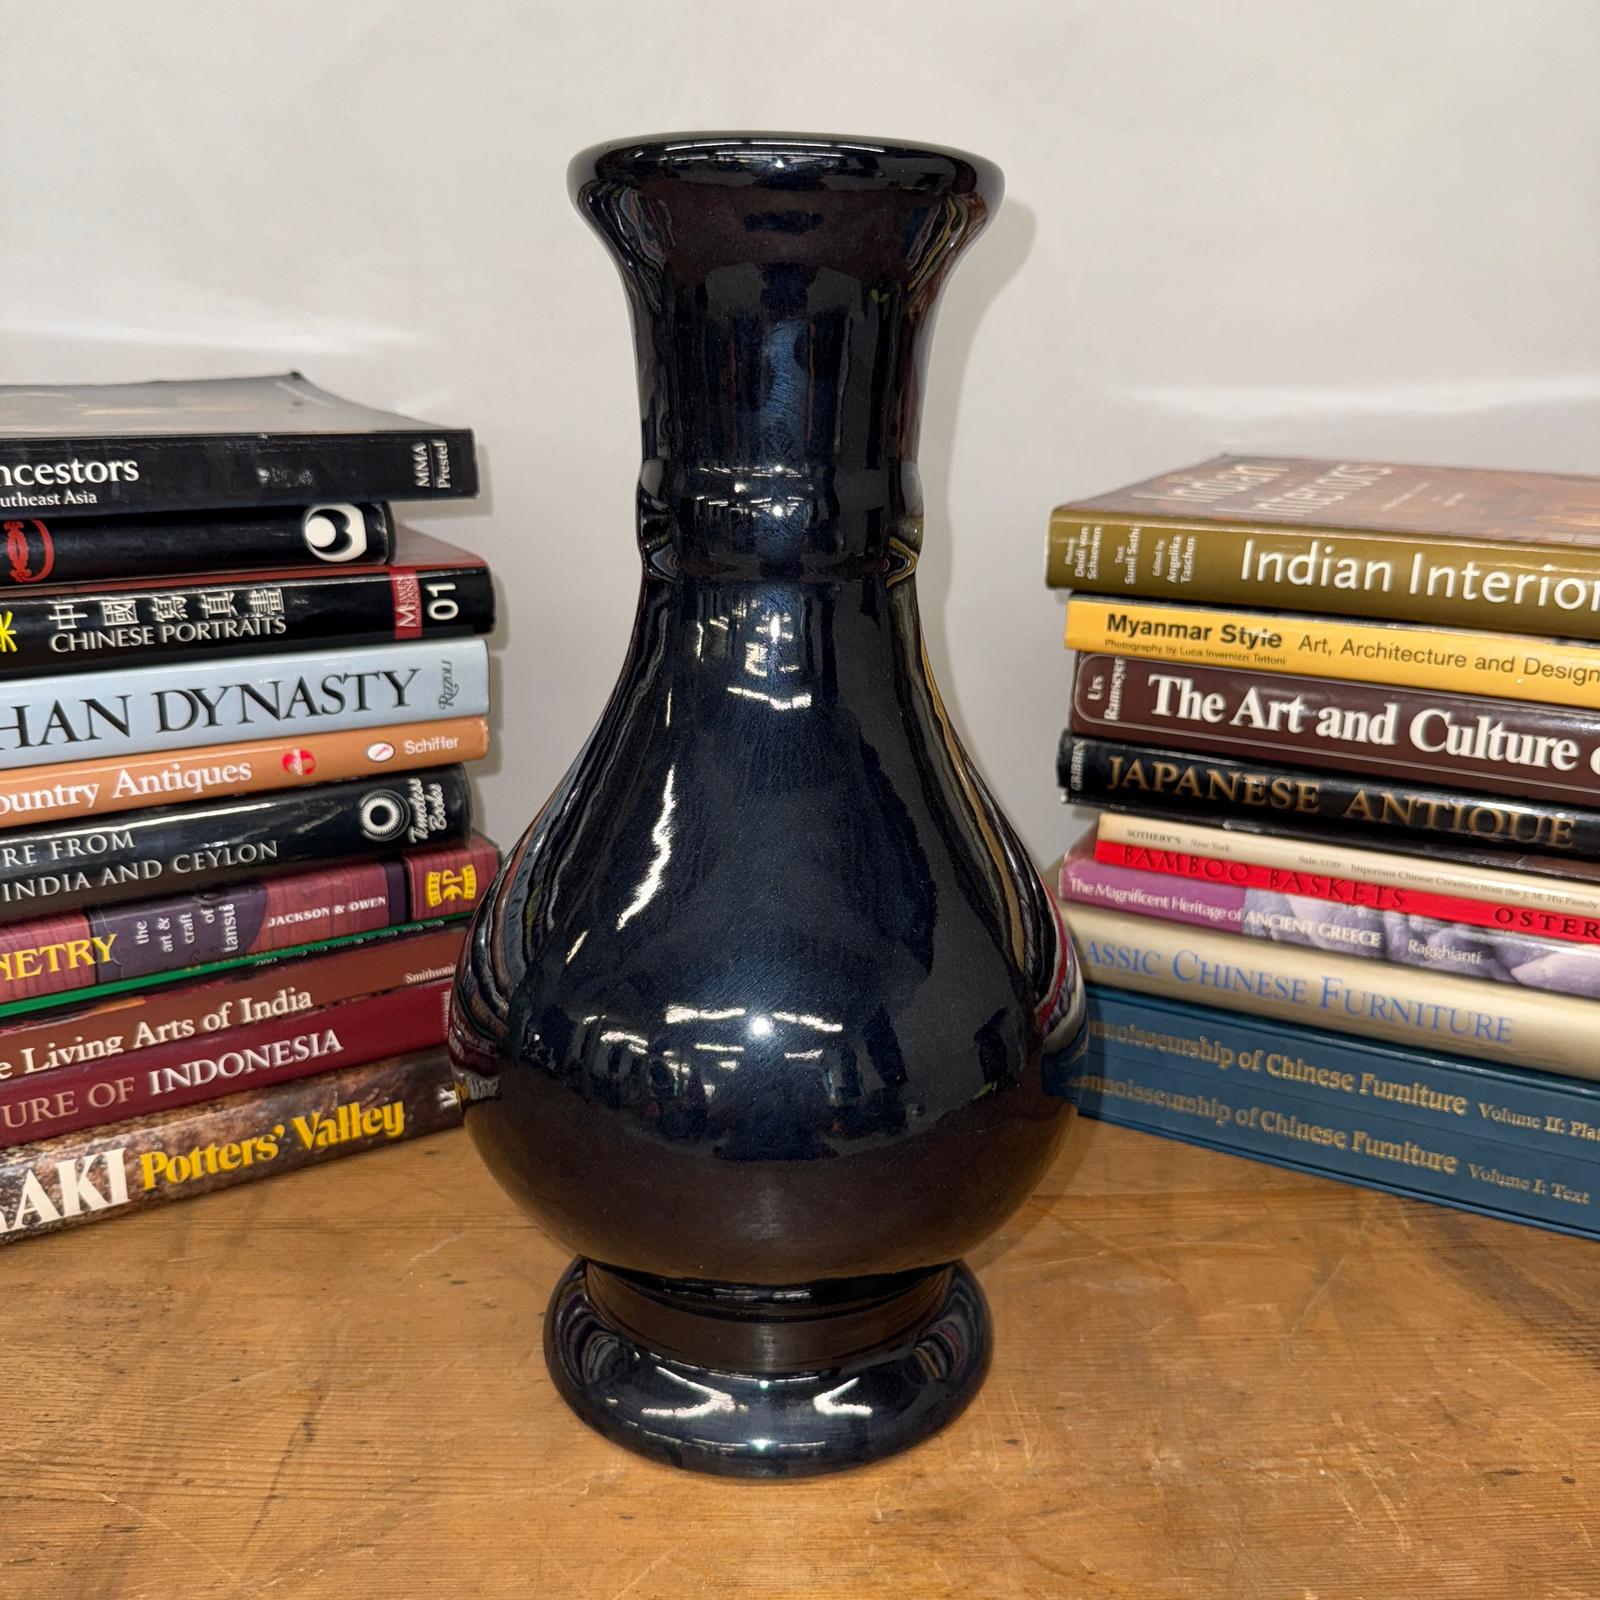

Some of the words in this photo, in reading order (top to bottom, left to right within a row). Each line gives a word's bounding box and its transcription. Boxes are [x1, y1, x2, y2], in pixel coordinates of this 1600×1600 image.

[0, 458, 139, 486] ncestors
[412, 442, 431, 487] MMA
[431, 439, 451, 488] Prestel
[64, 489, 98, 505] Asia
[1241, 539, 1391, 592] Indian
[426, 583, 459, 621] 01
[51, 625, 153, 653] CHINESE
[162, 614, 287, 643] PORTRAITS
[1105, 639, 1162, 654] Photography
[1166, 644, 1177, 656] by
[1180, 646, 1202, 657] Luca
[1253, 653, 1286, 665] Tettoni
[1106, 613, 1213, 641] Myanmar
[1219, 624, 1282, 650] Style
[1298, 634, 1332, 656] Art,
[1341, 638, 1467, 668] Architecture
[1475, 655, 1515, 673] and
[1523, 657, 1600, 686] Design
[0, 694, 132, 750] HAN
[151, 668, 422, 733] DYNASTY
[1148, 674, 1227, 723] The
[1229, 686, 1304, 734] Art
[1315, 702, 1400, 746] and
[1409, 708, 1580, 771] Culture
[404, 735, 459, 755] Schiffer
[112, 762, 252, 799] Antiques
[1106, 755, 1322, 814] JAPANESE
[1343, 789, 1576, 849] ANTIQUE
[4, 845, 37, 868] RE
[50, 830, 136, 860] FROM
[1126, 829, 1181, 844] SOTHEBY'S
[1, 872, 91, 902] INDIA
[101, 859, 163, 886] AND
[172, 839, 279, 874] CEYLON
[1123, 845, 1250, 882] BAMBOO
[1269, 868, 1405, 909] BASKETS
[1495, 908, 1600, 939] OSTER
[136, 920, 150, 945] the
[179, 911, 196, 944] craft
[267, 907, 330, 928] JACKSON
[333, 904, 346, 915] &
[350, 896, 387, 912] OWEN
[1069, 877, 1094, 895] The
[1094, 882, 1169, 910] Magnificent
[1171, 895, 1226, 922] Heritage
[1228, 907, 1244, 922] of
[1244, 911, 1315, 935] ANCIENT
[1318, 922, 1384, 949] GREECE
[1075, 936, 1161, 976] ASSIC
[1320, 975, 1515, 1043] FURNITURE
[21, 1035, 124, 1074] Living
[132, 1019, 195, 1049] Arts
[202, 1001, 234, 1031] of
[240, 986, 314, 1024] India
[2, 1091, 79, 1128] URE
[88, 1077, 136, 1109] OF
[148, 1028, 344, 1096] INDONESIA
[1238, 1048, 1264, 1072] of
[1266, 1053, 1355, 1094] Chinese
[1359, 1071, 1469, 1117] Furniture
[1478, 1102, 1541, 1130] Volume
[0, 1148, 131, 1234] AKI
[140, 1125, 285, 1192] Potters'
[291, 1101, 405, 1151] Valley
[1236, 1106, 1260, 1128] of
[1260, 1110, 1348, 1149] Chinese
[1352, 1130, 1459, 1175] Furniture
[1468, 1163, 1530, 1191] Volume
[1551, 1181, 1591, 1205] Text
